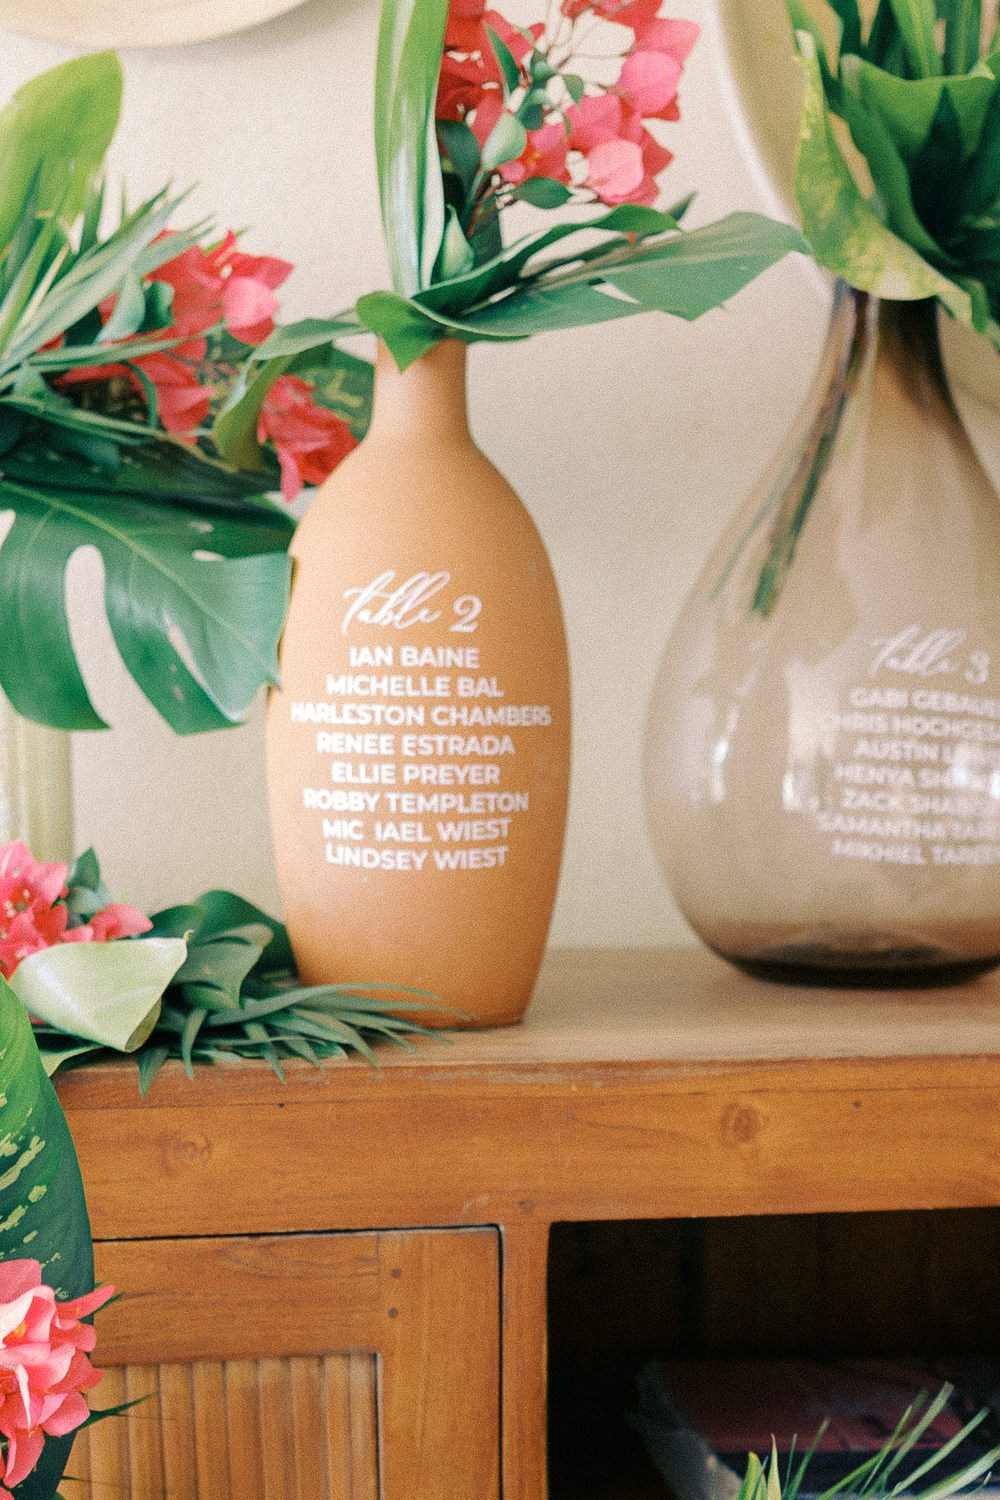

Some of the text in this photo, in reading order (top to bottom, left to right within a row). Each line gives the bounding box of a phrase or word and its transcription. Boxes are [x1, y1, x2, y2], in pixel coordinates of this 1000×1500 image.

[449, 594, 483, 634] 2
[349, 645, 480, 669] IAN BAINE
[963, 649, 991, 685] 3
[326, 674, 504, 698] MICHELLE BAL
[431, 705, 552, 727] CHAMBERS
[316, 730, 516, 756] RENEE ESTRADA
[331, 761, 501, 785] ELLIE PREYER
[303, 788, 530, 814] ROBBY TEMPLETON
[436, 818, 511, 842] WIEST
[326, 844, 509, 871] LINDSEY WIEST
